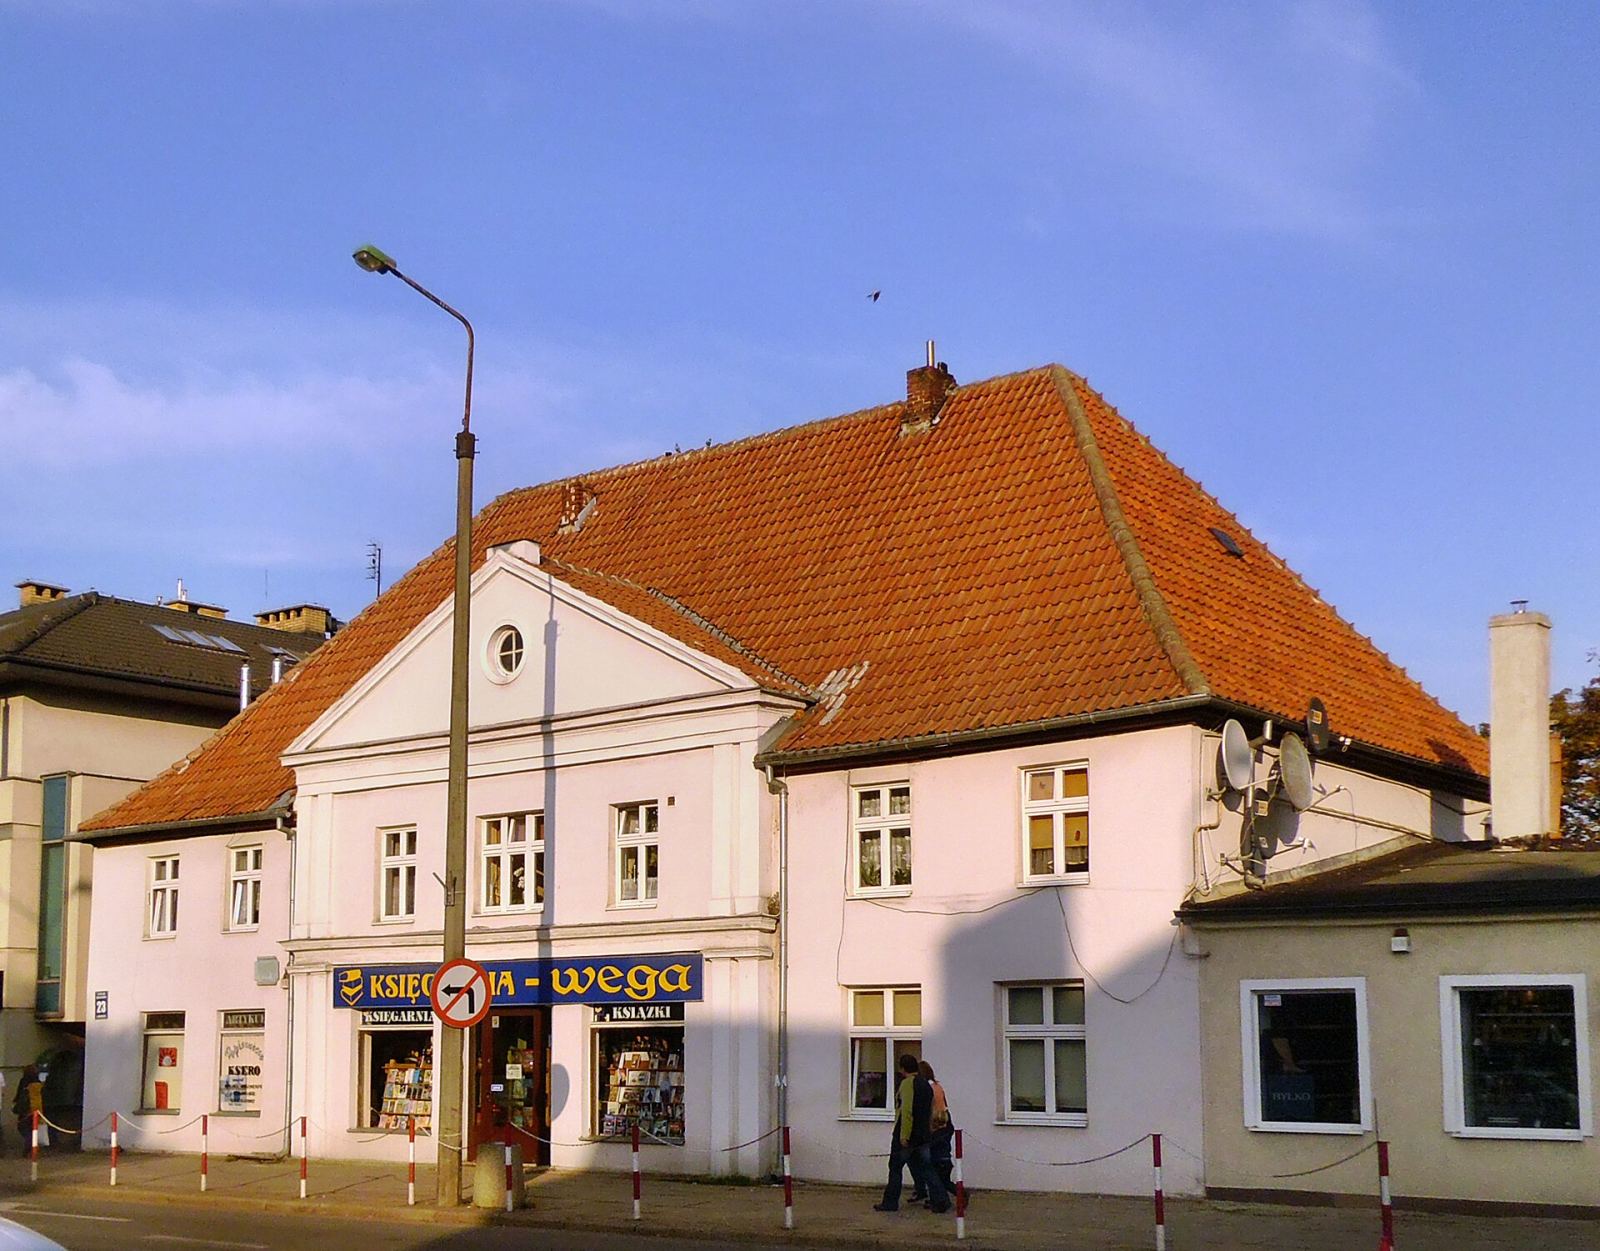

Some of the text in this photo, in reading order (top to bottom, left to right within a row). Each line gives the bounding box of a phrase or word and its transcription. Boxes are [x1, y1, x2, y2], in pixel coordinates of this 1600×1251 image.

[551, 964, 692, 1000] wega
[96, 1000, 106, 1013] 23
[228, 1065, 261, 1076] KSERO
